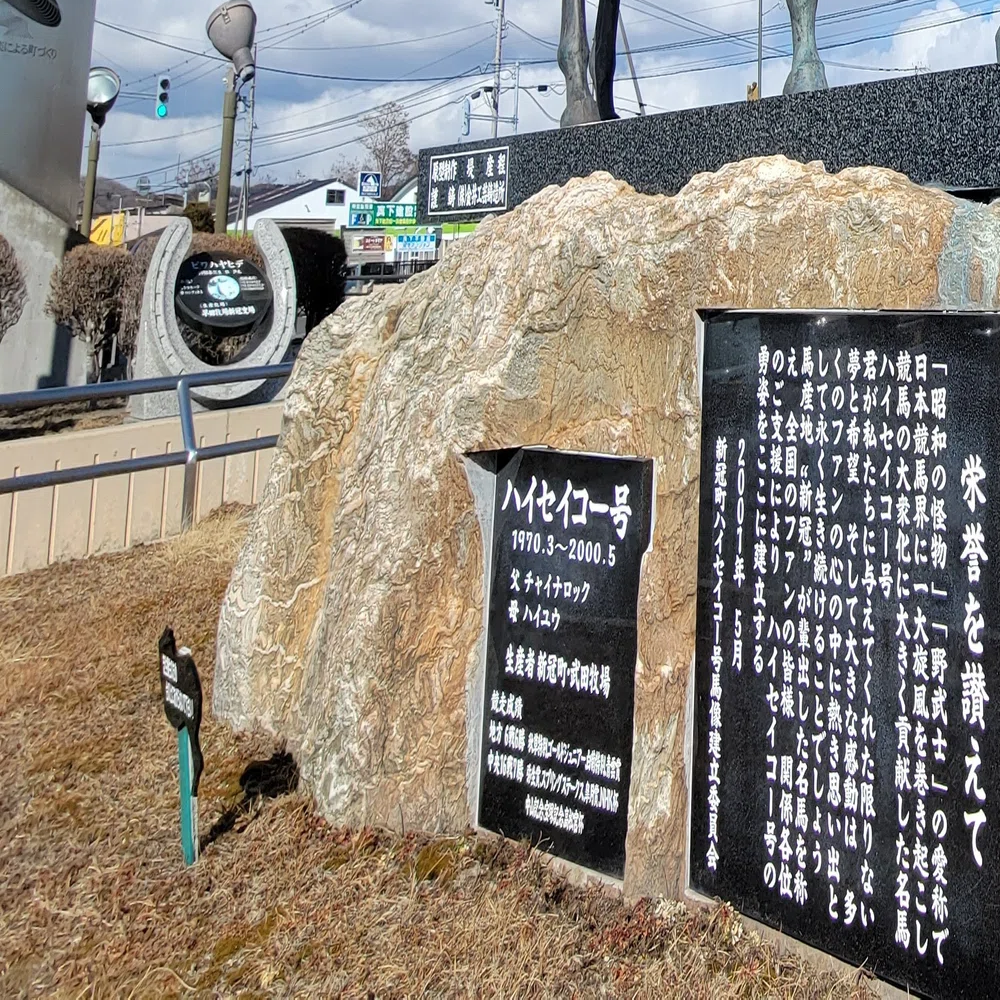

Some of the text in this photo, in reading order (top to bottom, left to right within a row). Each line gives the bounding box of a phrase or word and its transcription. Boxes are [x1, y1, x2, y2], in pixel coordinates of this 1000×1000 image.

[190, 259, 245, 270] ビワハヤヒデ
[847, 347, 861, 485] 夢と希望
[501, 475, 633, 541] ハイセイコー号
[508, 599, 561, 631] 母 ハイユウ
[510, 567, 591, 603] 父 チャイナロック
[732, 438, 746, 672] 2001年 5月
[753, 345, 769, 674] 勇姿をここに建立する
[764, 350, 785, 888] のご支援により ハイセイコー号の
[812, 349, 829, 874] して永く生き続けることでしょう
[827, 348, 846, 920] くのファンの心の中に熱き思い出と
[861, 349, 878, 927] 君が私たちに与えてくれた限りない
[878, 354, 896, 600] ハイセイコー号
[505, 643, 535, 679] 生産者
[843, 522, 860, 850] そして大きな感動は
[895, 350, 912, 949] 競馬の大衆化に大きく貢献した名馬
[912, 354, 930, 955] 日本競馬界に一大旋風を巻き起こし
[931, 360, 950, 965] 「昭和の怪物」「野武士」の愛称で
[960, 454, 989, 868] 栄誉を讃えて
[779, 755, 796, 899] 関係各位
